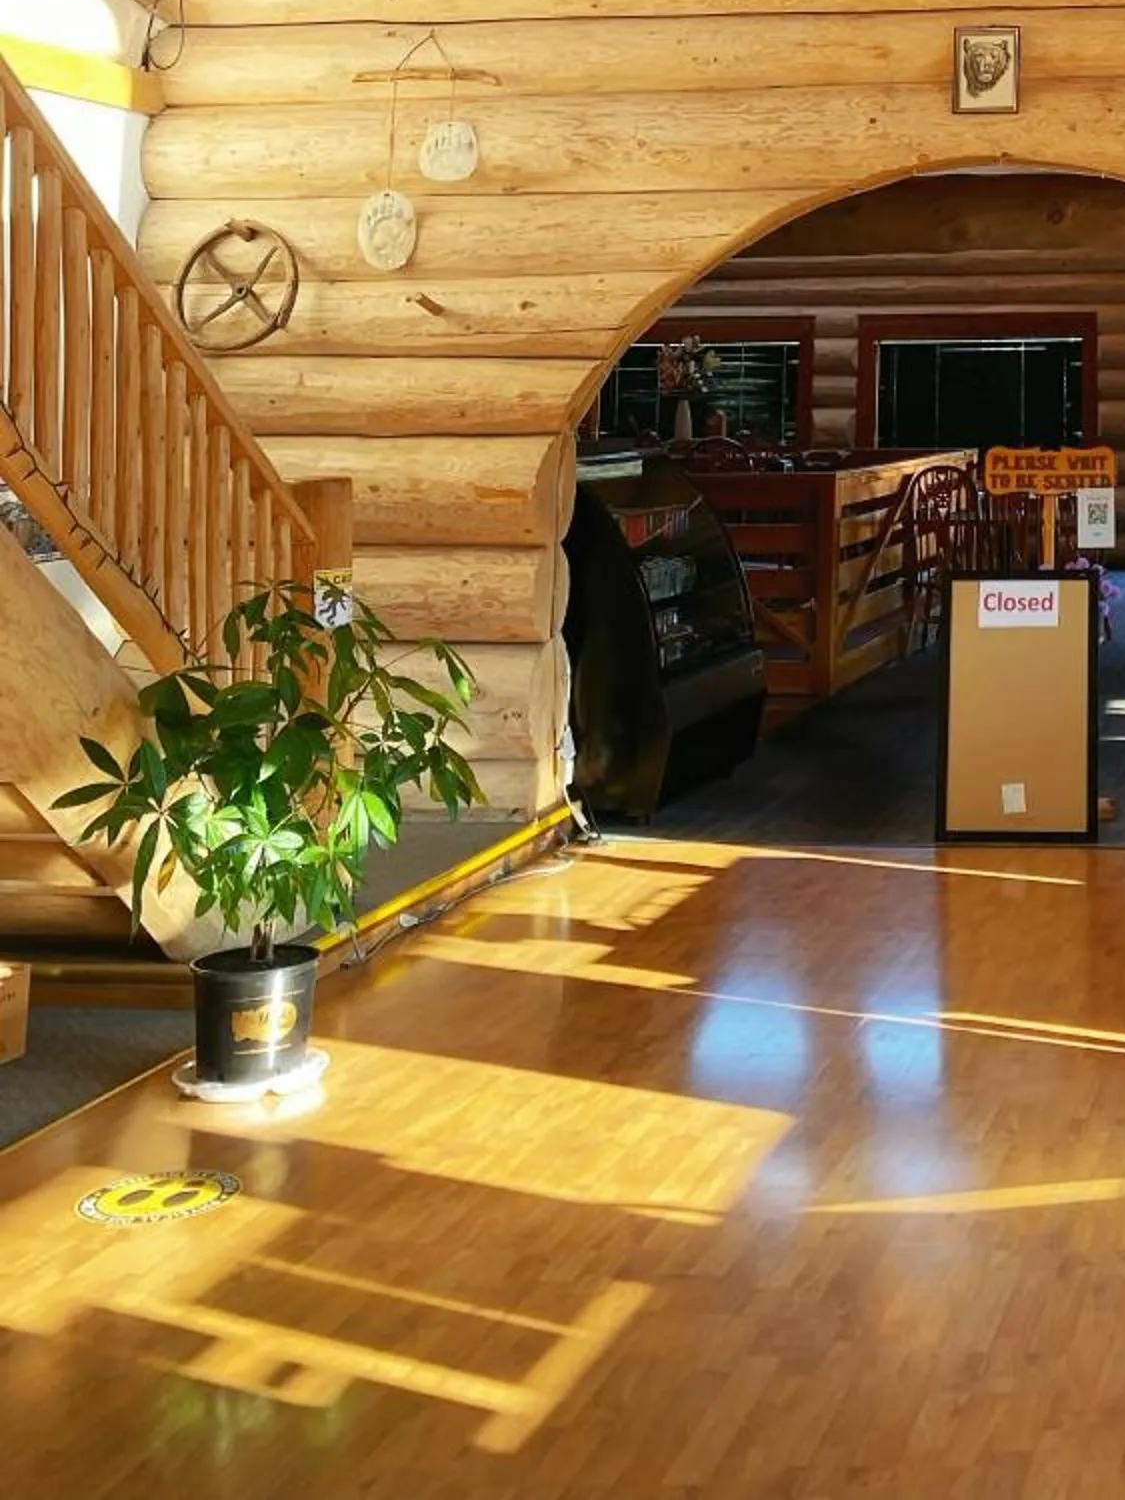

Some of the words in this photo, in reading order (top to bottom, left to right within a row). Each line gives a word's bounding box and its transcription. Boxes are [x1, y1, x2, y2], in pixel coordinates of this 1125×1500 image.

[991, 455, 1058, 470] PLEASE
[1067, 455, 1108, 470] WAIT
[989, 473, 1011, 489] TO
[1015, 473, 1038, 489] BE
[1043, 474, 1113, 490] SEATED
[983, 592, 1054, 612] Closed
